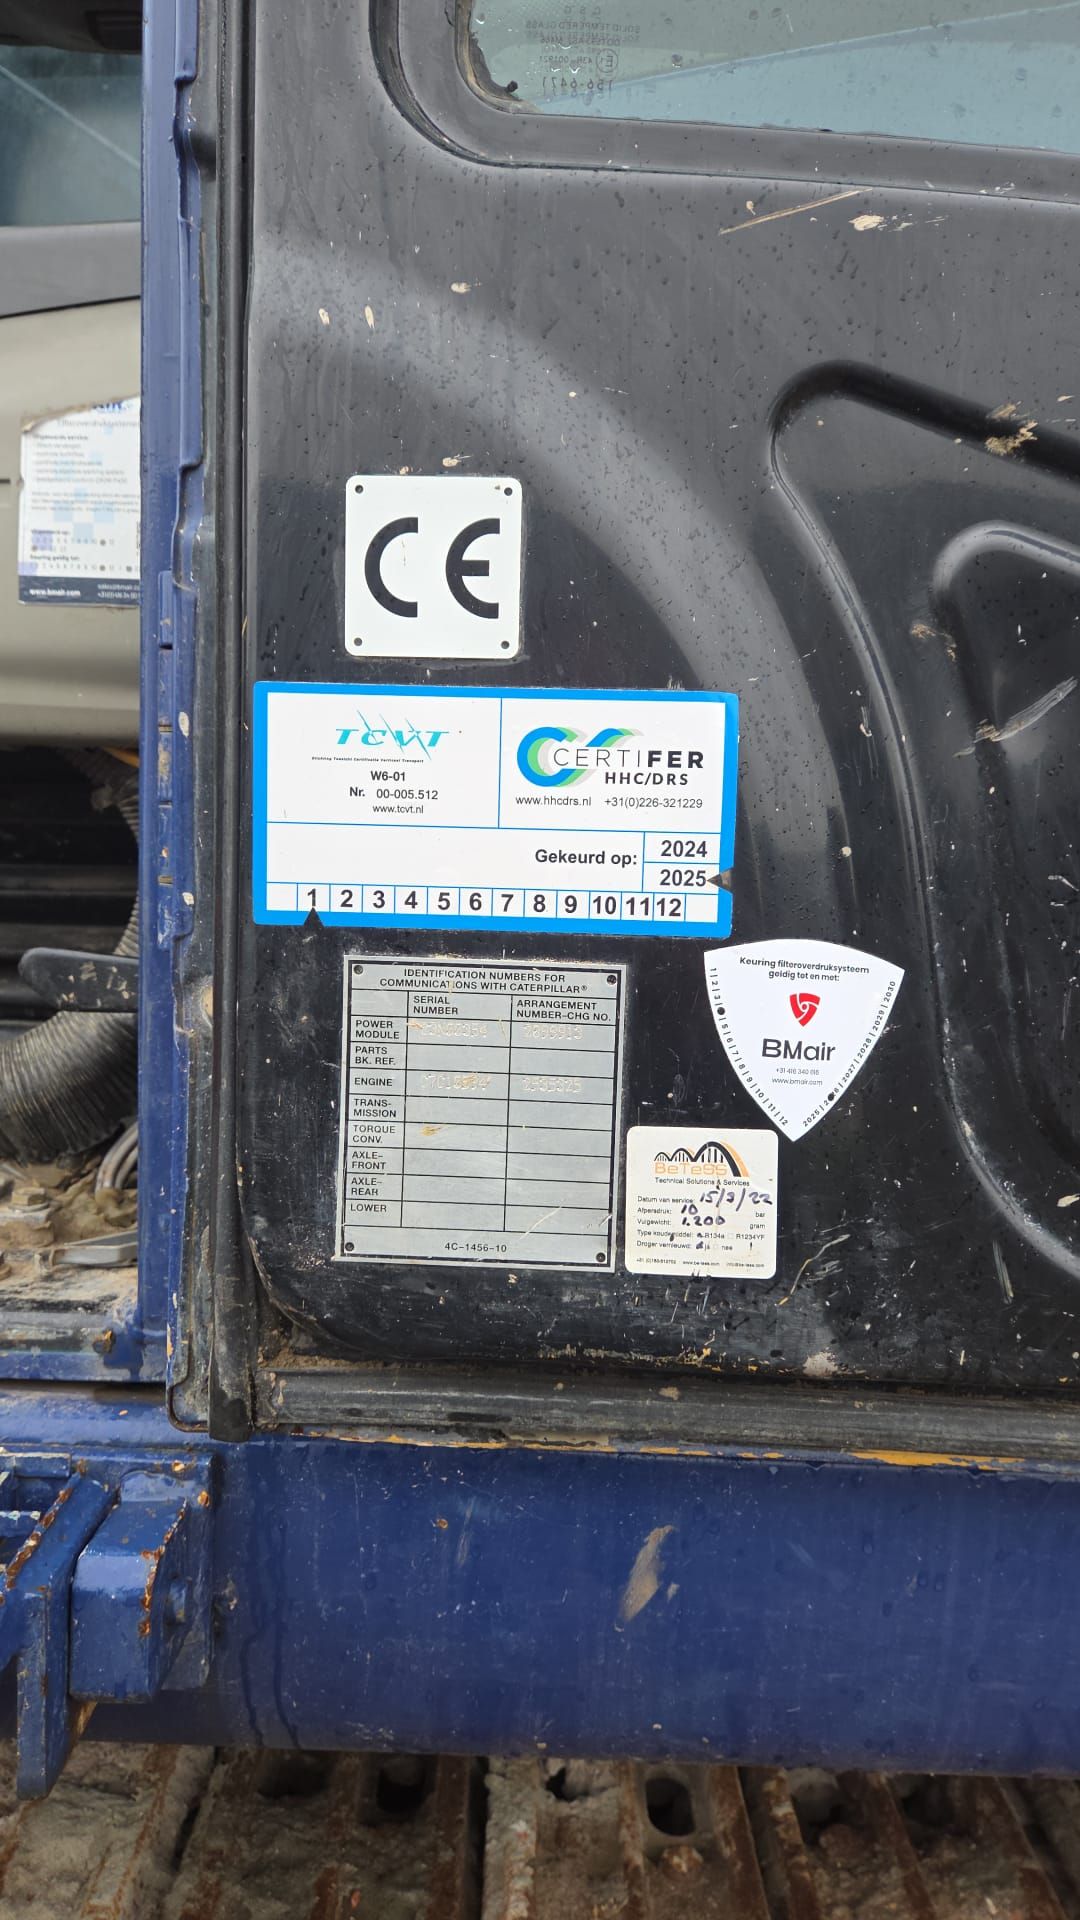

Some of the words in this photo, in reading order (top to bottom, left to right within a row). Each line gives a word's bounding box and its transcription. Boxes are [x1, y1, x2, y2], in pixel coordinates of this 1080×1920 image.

[364, 516, 501, 620] CE
[553, 748, 704, 768] CERTIFER
[370, 770, 406, 782] W6-01
[605, 772, 688, 786] HHC/DRS
[349, 786, 365, 797] Nr.
[376, 788, 439, 800] 00-005.512
[515, 795, 592, 806] www.hhcdrs.nl
[604, 796, 703, 809] +31(0)226-321229
[372, 804, 424, 814] www.tcvt.nl
[660, 839, 708, 859] 2024
[535, 848, 605, 866] Gekeurd
[611, 851, 637, 869] op:
[659, 869, 707, 888] 2025
[307, 888, 317, 907] 1
[340, 889, 353, 908] 2
[372, 890, 386, 909] 3
[404, 891, 418, 909] 4
[437, 892, 451, 911] 5
[469, 893, 483, 911] 6
[501, 894, 514, 912] 7
[532, 895, 546, 913] 8
[564, 895, 578, 914] 9
[593, 896, 617, 915] 10
[627, 897, 650, 916] 11
[656, 898, 682, 917] 12
[740, 956, 776, 969] Keuring
[777, 959, 870, 974] filteroverdruksysteem
[404, 968, 488, 980] IDENTIFICATION
[489, 972, 541, 982] NUMBERS
[544, 974, 565, 983] FOR
[768, 970, 795, 981] geldig
[797, 971, 808, 979] tot
[481, 982, 506, 991] WITH
[413, 996, 450, 1005] SERIAL
[516, 999, 597, 1011] ARRANGEMENT
[413, 1006, 458, 1015] NUMBER
[593, 1013, 611, 1022] NO.
[355, 1020, 393, 1028] POWER
[355, 1030, 399, 1039] MODULE
[355, 1046, 388, 1055] PARTS
[761, 1038, 836, 1061] BMair
[803, 1110, 820, 1127] 2025
[823, 1087, 840, 1106] 26
[842, 1063, 856, 1082] 2027
[857, 1037, 872, 1059] 2028
[872, 1010, 885, 1032] 2029
[884, 981, 896, 1002] 2030
[355, 1056, 371, 1064] BK.
[375, 1057, 396, 1066] REF.
[354, 1077, 393, 1087] ENGINE
[354, 1098, 391, 1107] TRANS-
[353, 1109, 397, 1118] MISSION
[353, 1124, 396, 1134] TORQUE
[352, 1135, 382, 1144] CONV.
[351, 1151, 383, 1160] AXLE-
[351, 1161, 386, 1170] FRONT
[351, 1177, 382, 1186] AXLE-
[655, 1177, 684, 1185] Technical
[686, 1178, 715, 1186] Solutions
[723, 1179, 750, 1187] Services
[351, 1187, 378, 1196] REAR
[350, 1203, 387, 1213] LOWER
[637, 1208, 672, 1216] Afpersdruk:
[637, 1219, 671, 1227] Vulgewicht:
[637, 1230, 652, 1238] Type
[444, 1242, 507, 1254] 4C-1456-10
[637, 1240, 658, 1248] Droger
